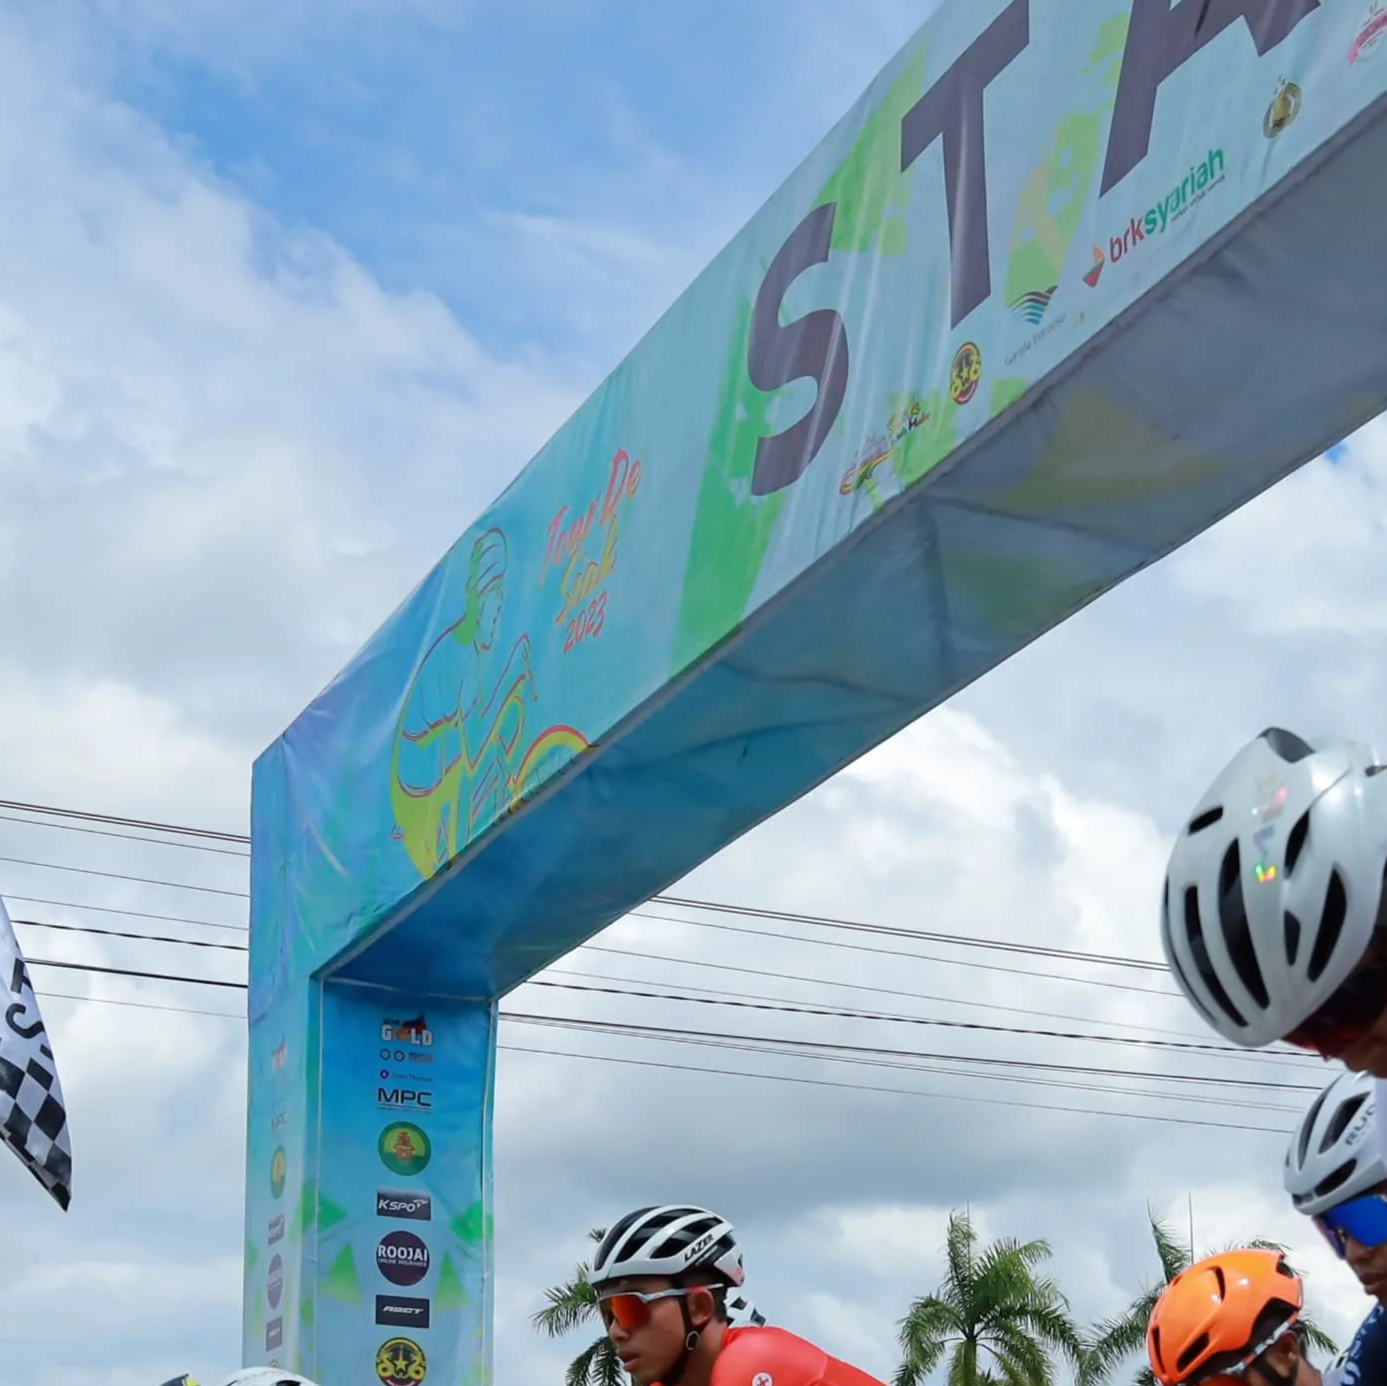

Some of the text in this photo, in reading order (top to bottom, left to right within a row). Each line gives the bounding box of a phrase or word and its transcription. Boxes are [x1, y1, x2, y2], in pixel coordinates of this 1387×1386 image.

[1109, 148, 1224, 263] brksyariah
[600, 448, 643, 524] De
[563, 590, 608, 655] 2023
[377, 1087, 432, 1107] MPC
[378, 1199, 416, 1213] KSPO
[377, 1244, 428, 1262] ROOJAI
[684, 1234, 714, 1263] LAZER
